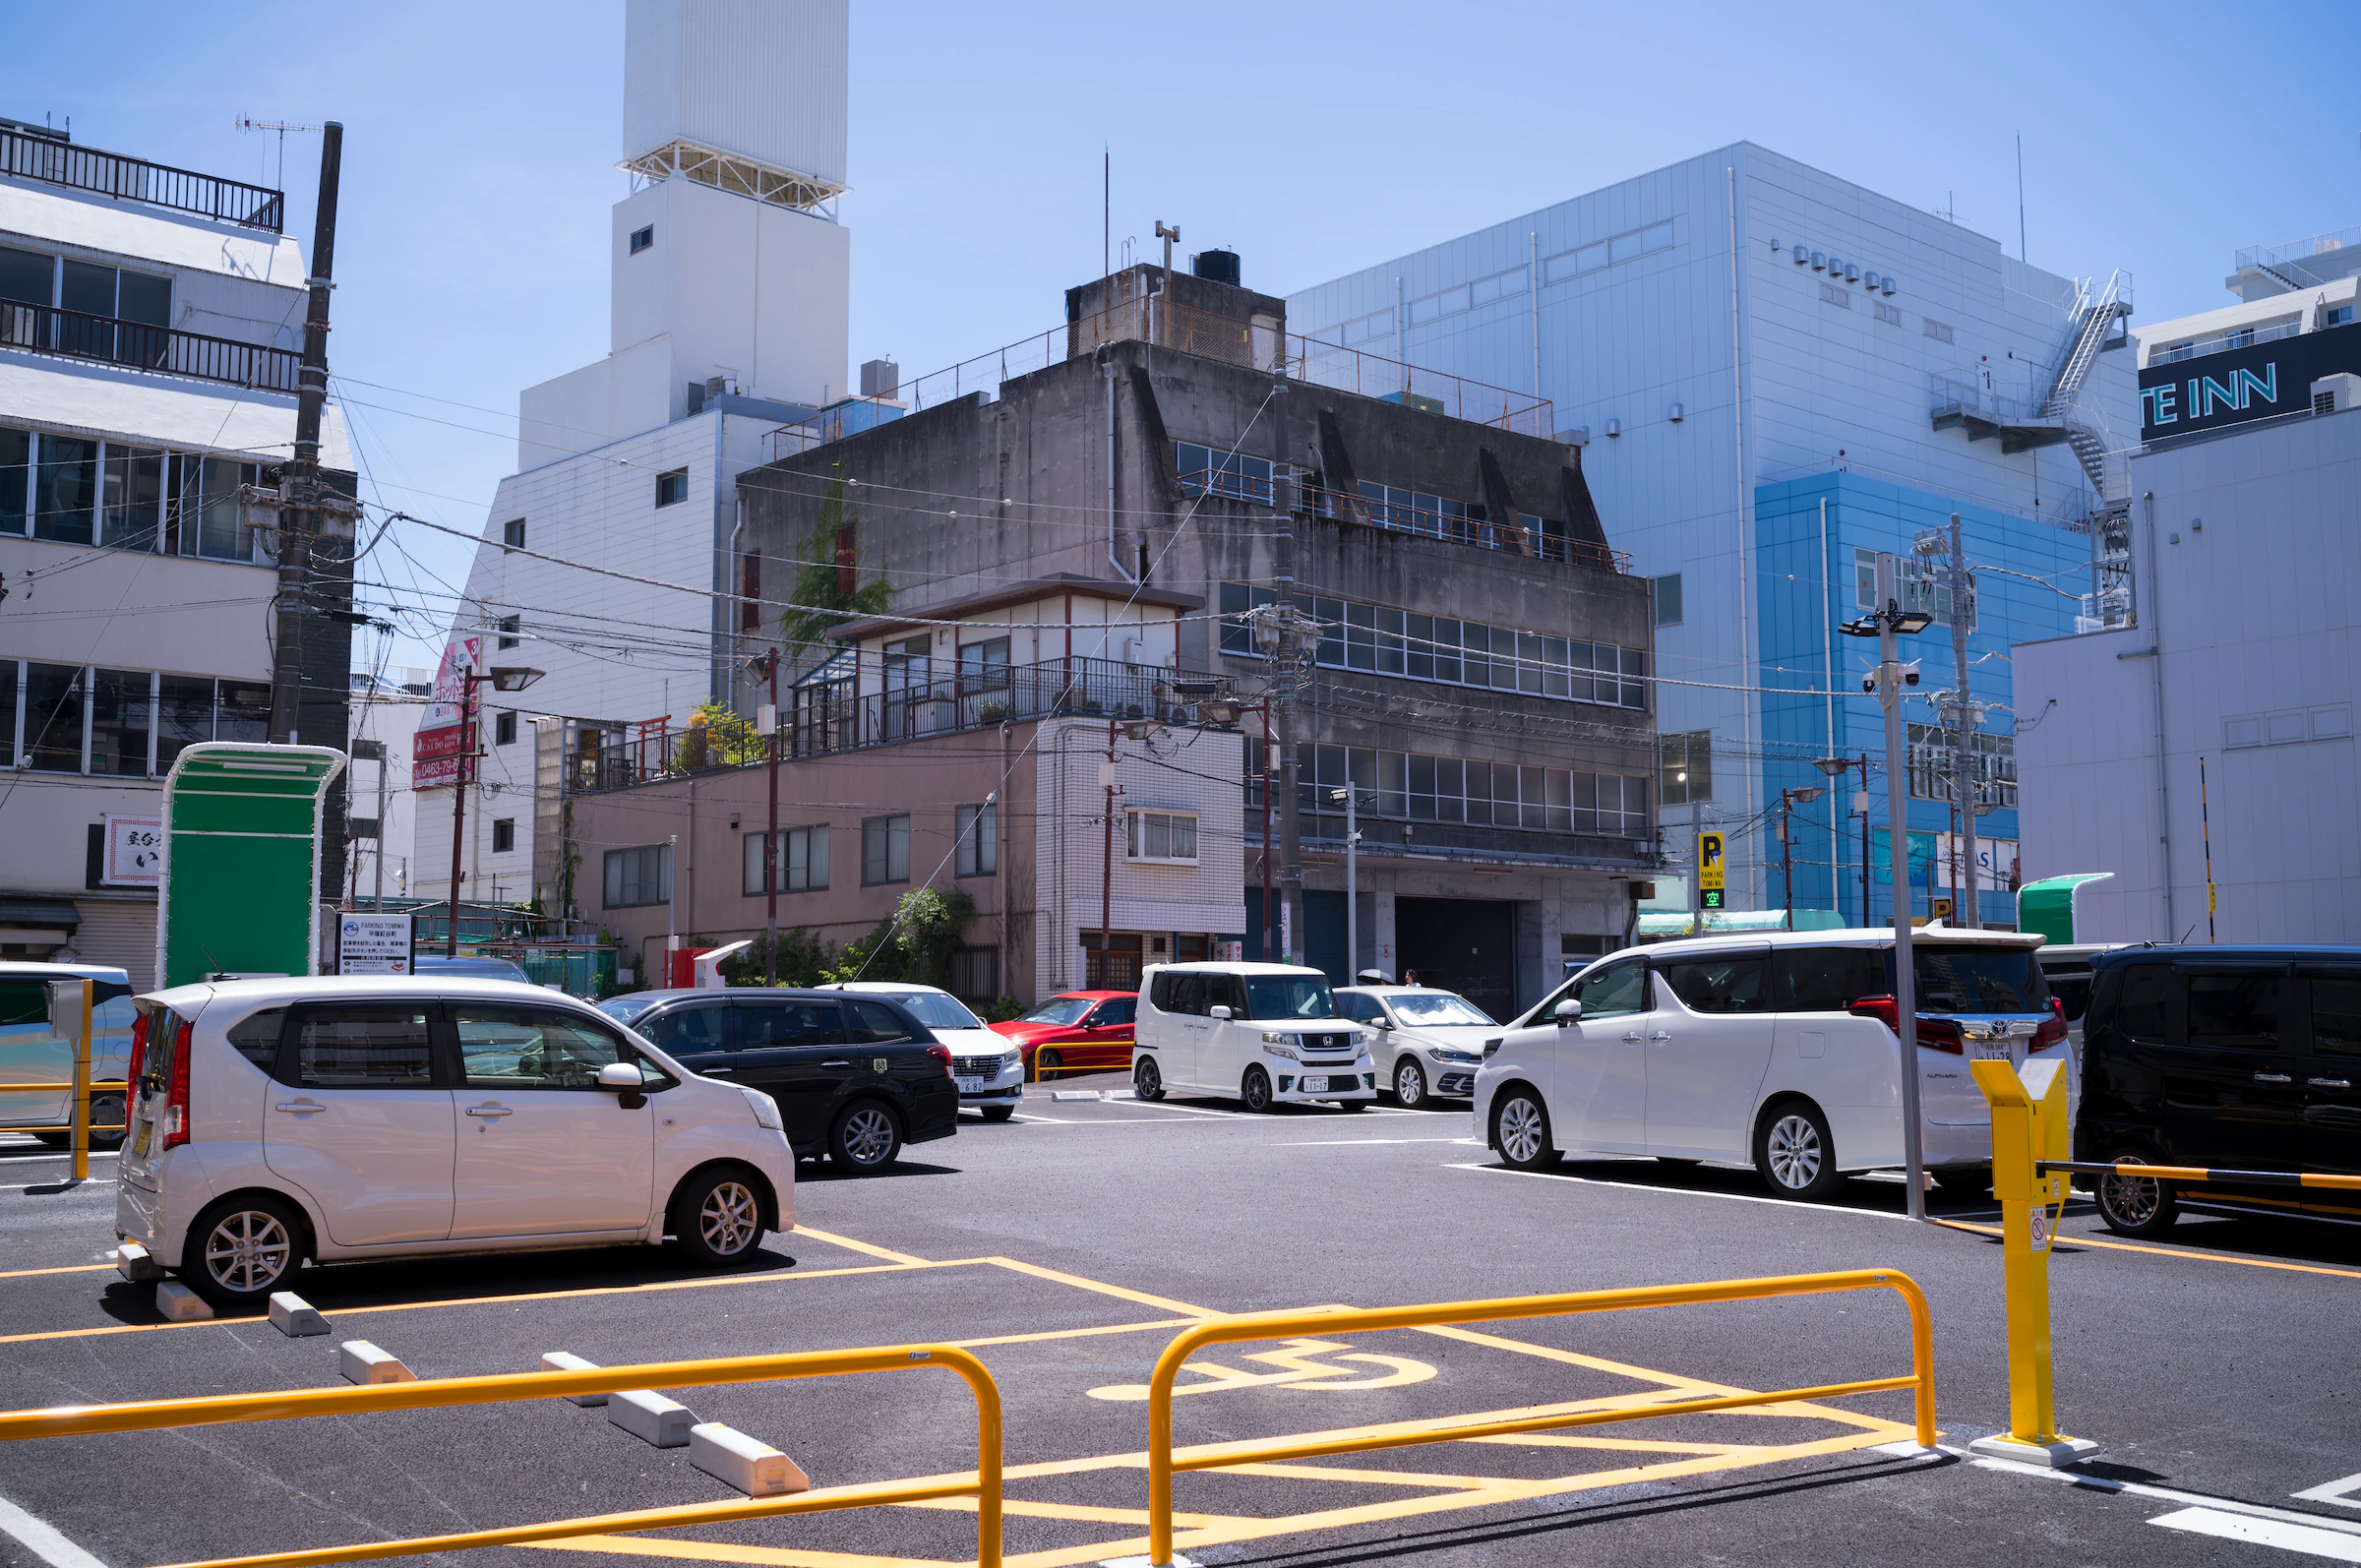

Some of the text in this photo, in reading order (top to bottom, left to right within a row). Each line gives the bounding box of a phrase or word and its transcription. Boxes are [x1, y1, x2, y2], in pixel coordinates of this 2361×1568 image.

[2188, 362, 2277, 419] INN
[422, 740, 444, 752] CALDO
[1703, 836, 1721, 867] P
[1706, 891, 1719, 906] 空
[1935, 901, 1951, 919] P
